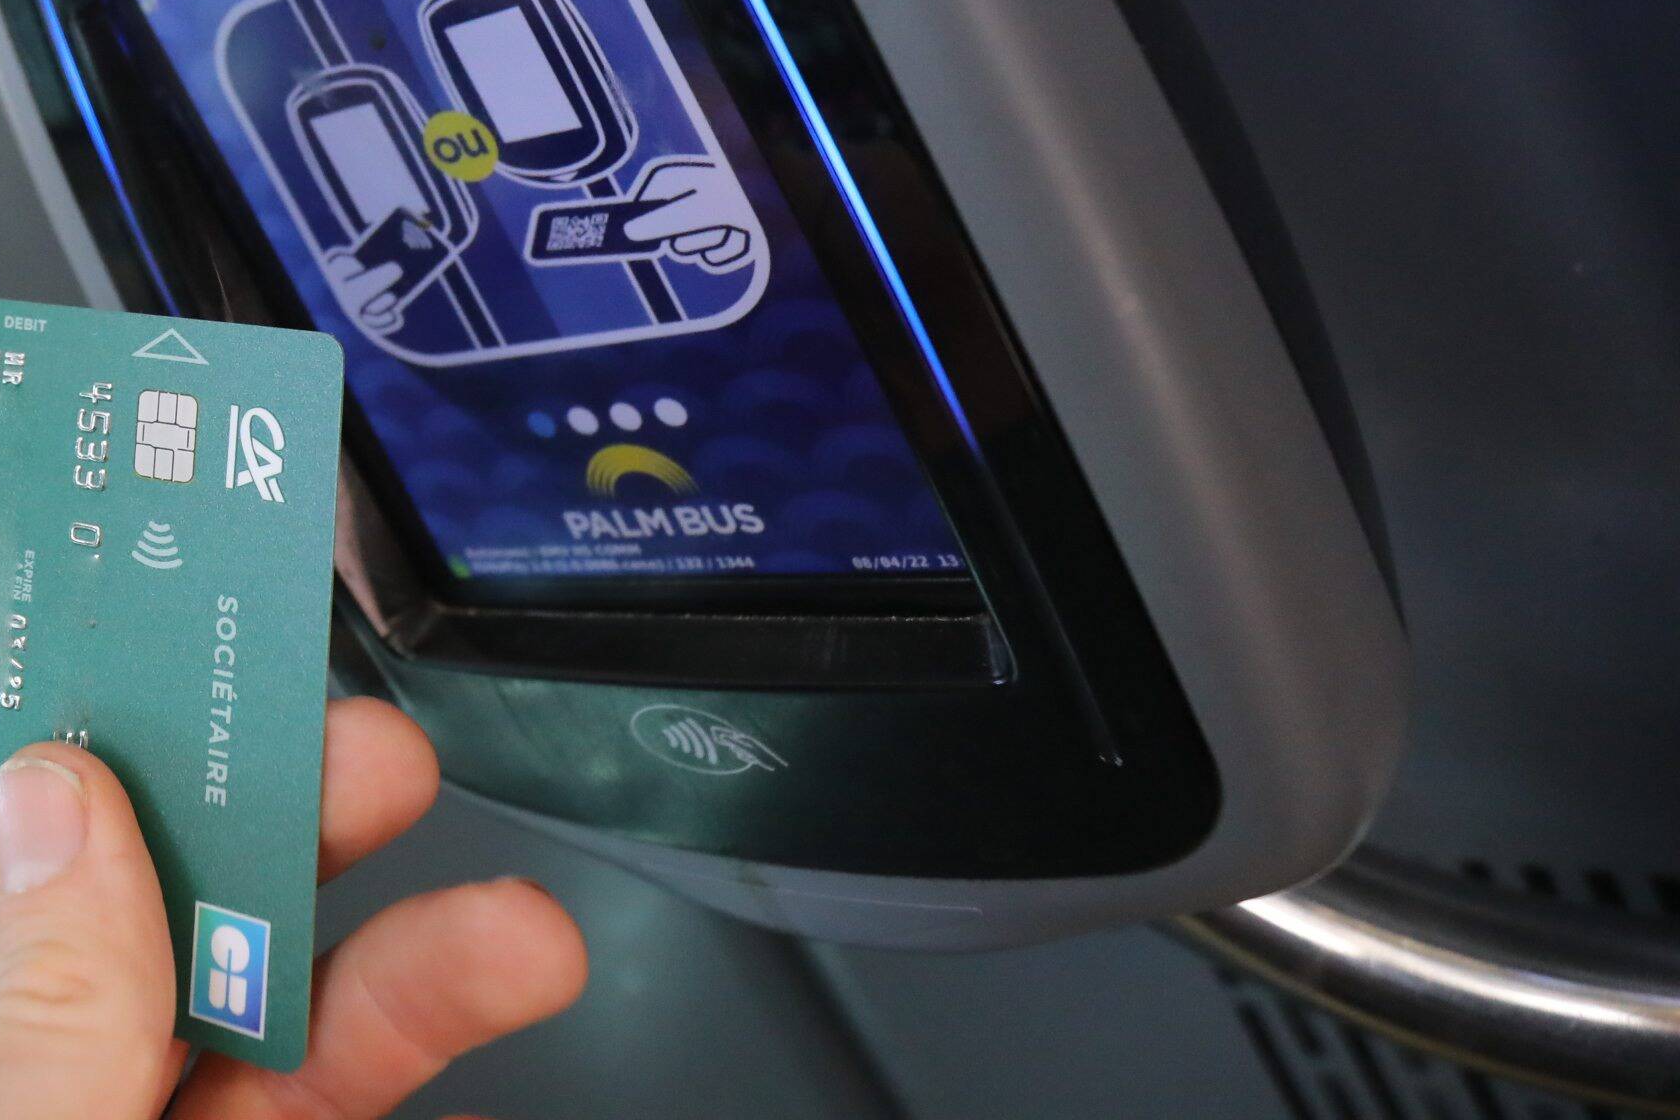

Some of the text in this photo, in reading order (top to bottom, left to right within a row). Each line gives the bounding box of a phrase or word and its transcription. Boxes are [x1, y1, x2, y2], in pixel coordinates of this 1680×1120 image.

[433, 128, 488, 164] ou
[4, 315, 48, 332] DEBIT
[73, 382, 113, 491] 4533
[563, 503, 766, 540] PALM BUS
[21, 549, 36, 602] EXPIRE
[204, 595, 239, 807] SOCIÉTAIRE
